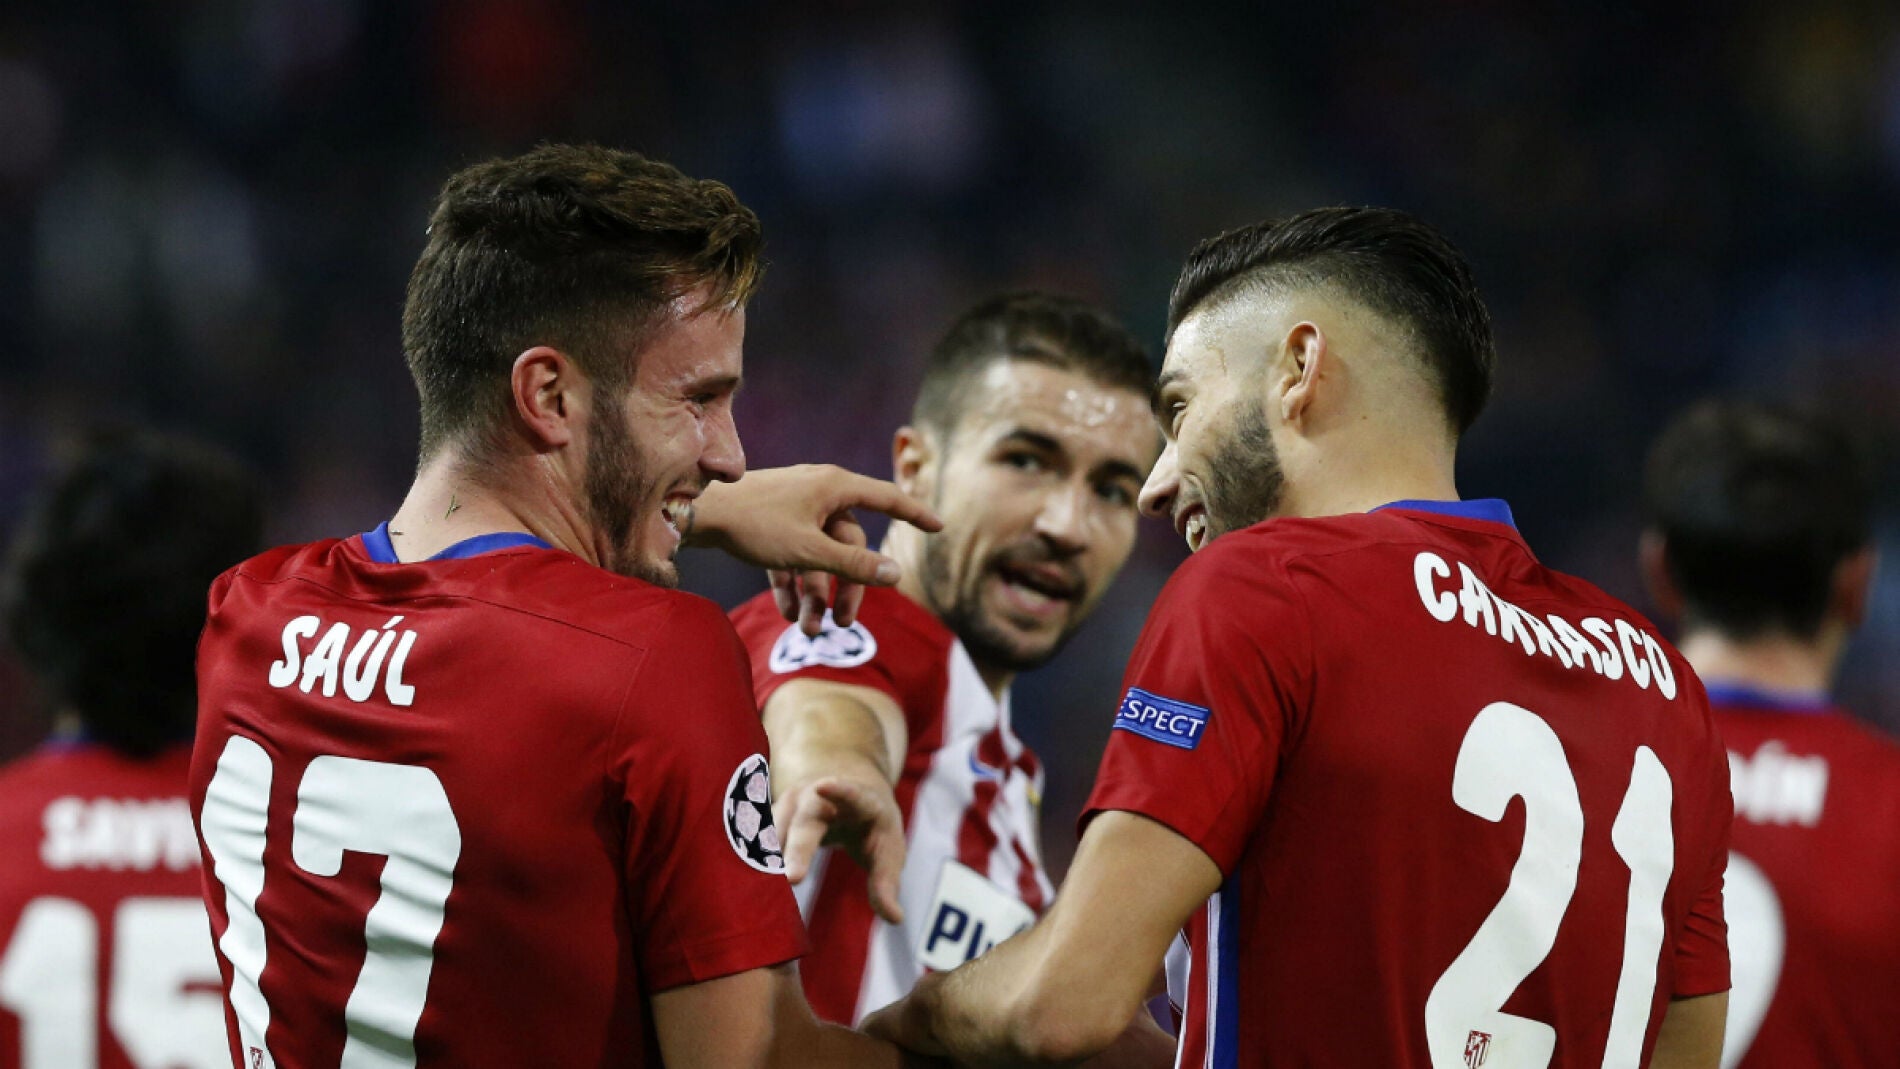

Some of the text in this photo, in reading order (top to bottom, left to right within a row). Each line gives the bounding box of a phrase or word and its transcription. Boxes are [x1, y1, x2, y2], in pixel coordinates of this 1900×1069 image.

[269, 615, 418, 706] SAÚL
[1413, 551, 1677, 700] CARRASCO
[200, 734, 462, 1069] 17
[1425, 701, 1675, 1069] 21
